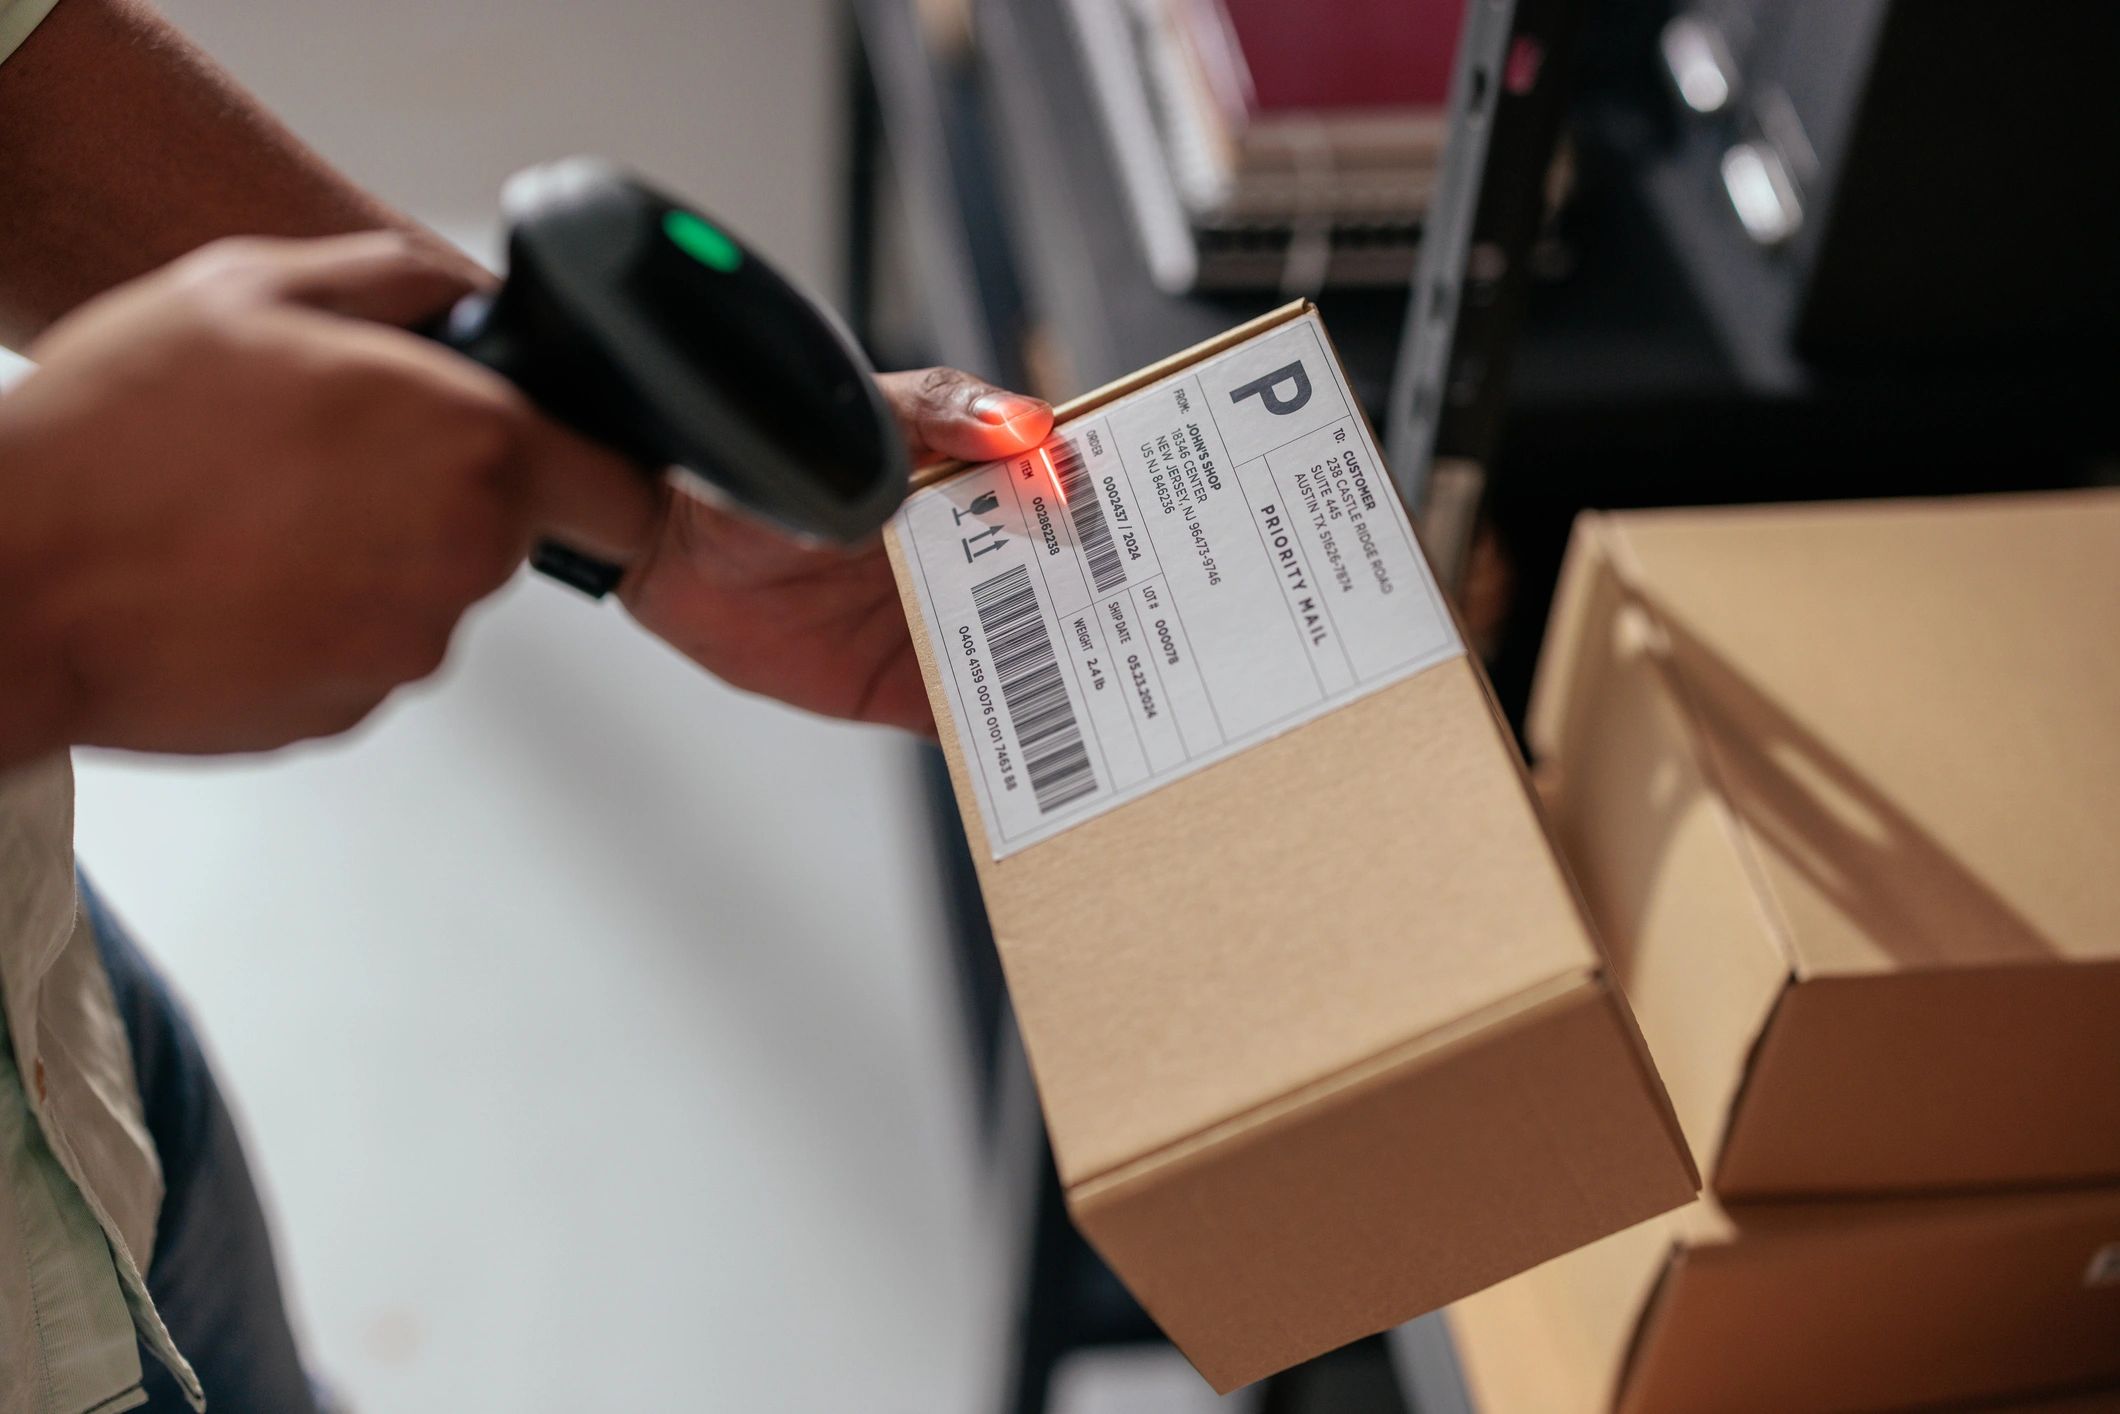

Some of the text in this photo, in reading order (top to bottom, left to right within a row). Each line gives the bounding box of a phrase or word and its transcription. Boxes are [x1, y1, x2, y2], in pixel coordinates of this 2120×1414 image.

[1228, 359, 1313, 416] P
[1171, 427, 1208, 504] 18346 CENTER
[1173, 388, 1222, 491] FROM: JOHN'S SHOP
[1332, 427, 1376, 511] TO: CUSTOMER
[1019, 459, 1060, 556] ITEM 002862238
[1086, 429, 1104, 458] ORDER
[1102, 476, 1129, 522] 0002437
[1122, 531, 1142, 561] 2024
[1140, 441, 1176, 515] US NJ 846236
[1155, 435, 1222, 586] NEW JERSEY, NJ 96473-9746
[1294, 473, 1320, 514] AUSTIN
[1312, 512, 1328, 531] TX
[1310, 464, 1343, 520] SUITE 445
[1326, 457, 1394, 595] 238 CASTLE RIDGE ROAD
[1260, 503, 1326, 646] PRIORITY MAIL
[958, 625, 976, 657] 0406
[968, 658, 985, 684] 4159
[1073, 617, 1106, 691] WEIGHT 2.4 lb
[1107, 601, 1157, 719] SHIP DATE 05.23.2024
[1154, 619, 1180, 665] 000078
[976, 685, 995, 716] 0076
[986, 716, 1003, 744] 0101
[994, 743, 1013, 774] 7463
